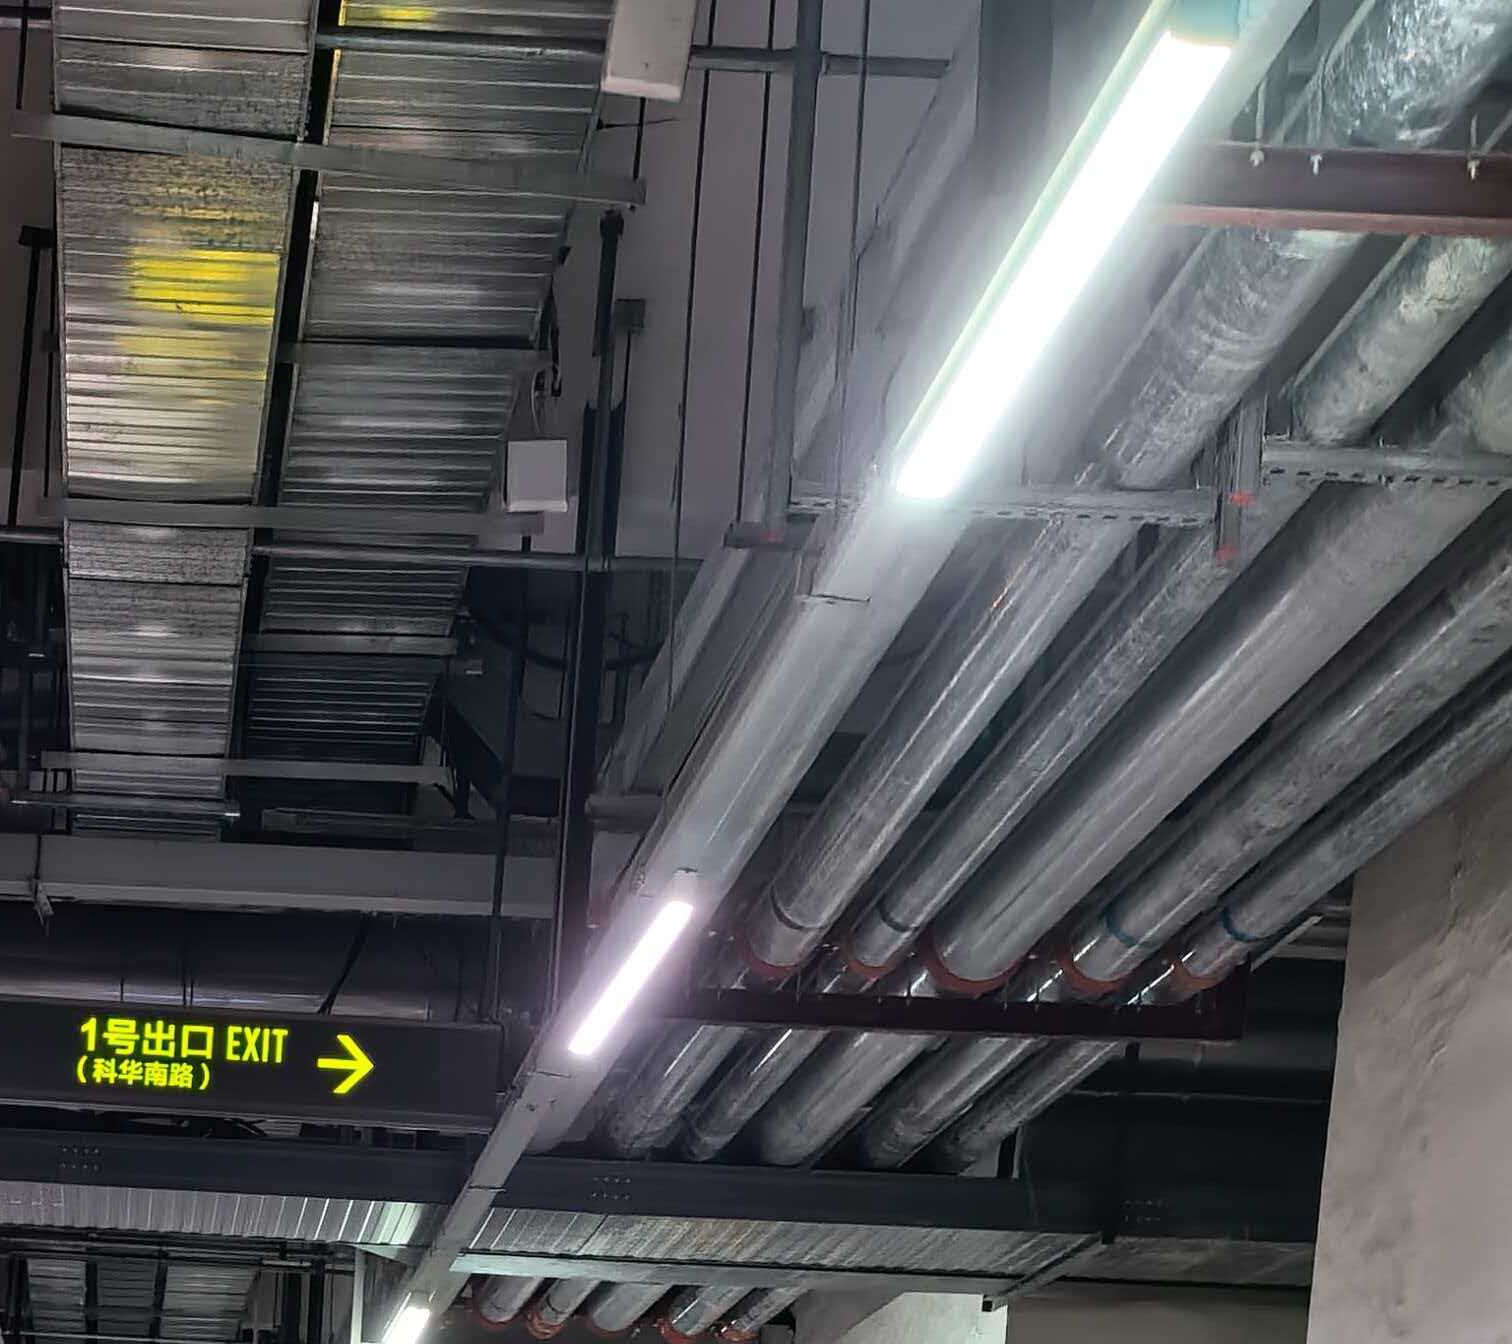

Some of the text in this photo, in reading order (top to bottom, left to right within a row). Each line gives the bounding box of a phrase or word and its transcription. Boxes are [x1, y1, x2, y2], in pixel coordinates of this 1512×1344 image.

[79, 1017, 288, 1064] 1号出口 EXIT
